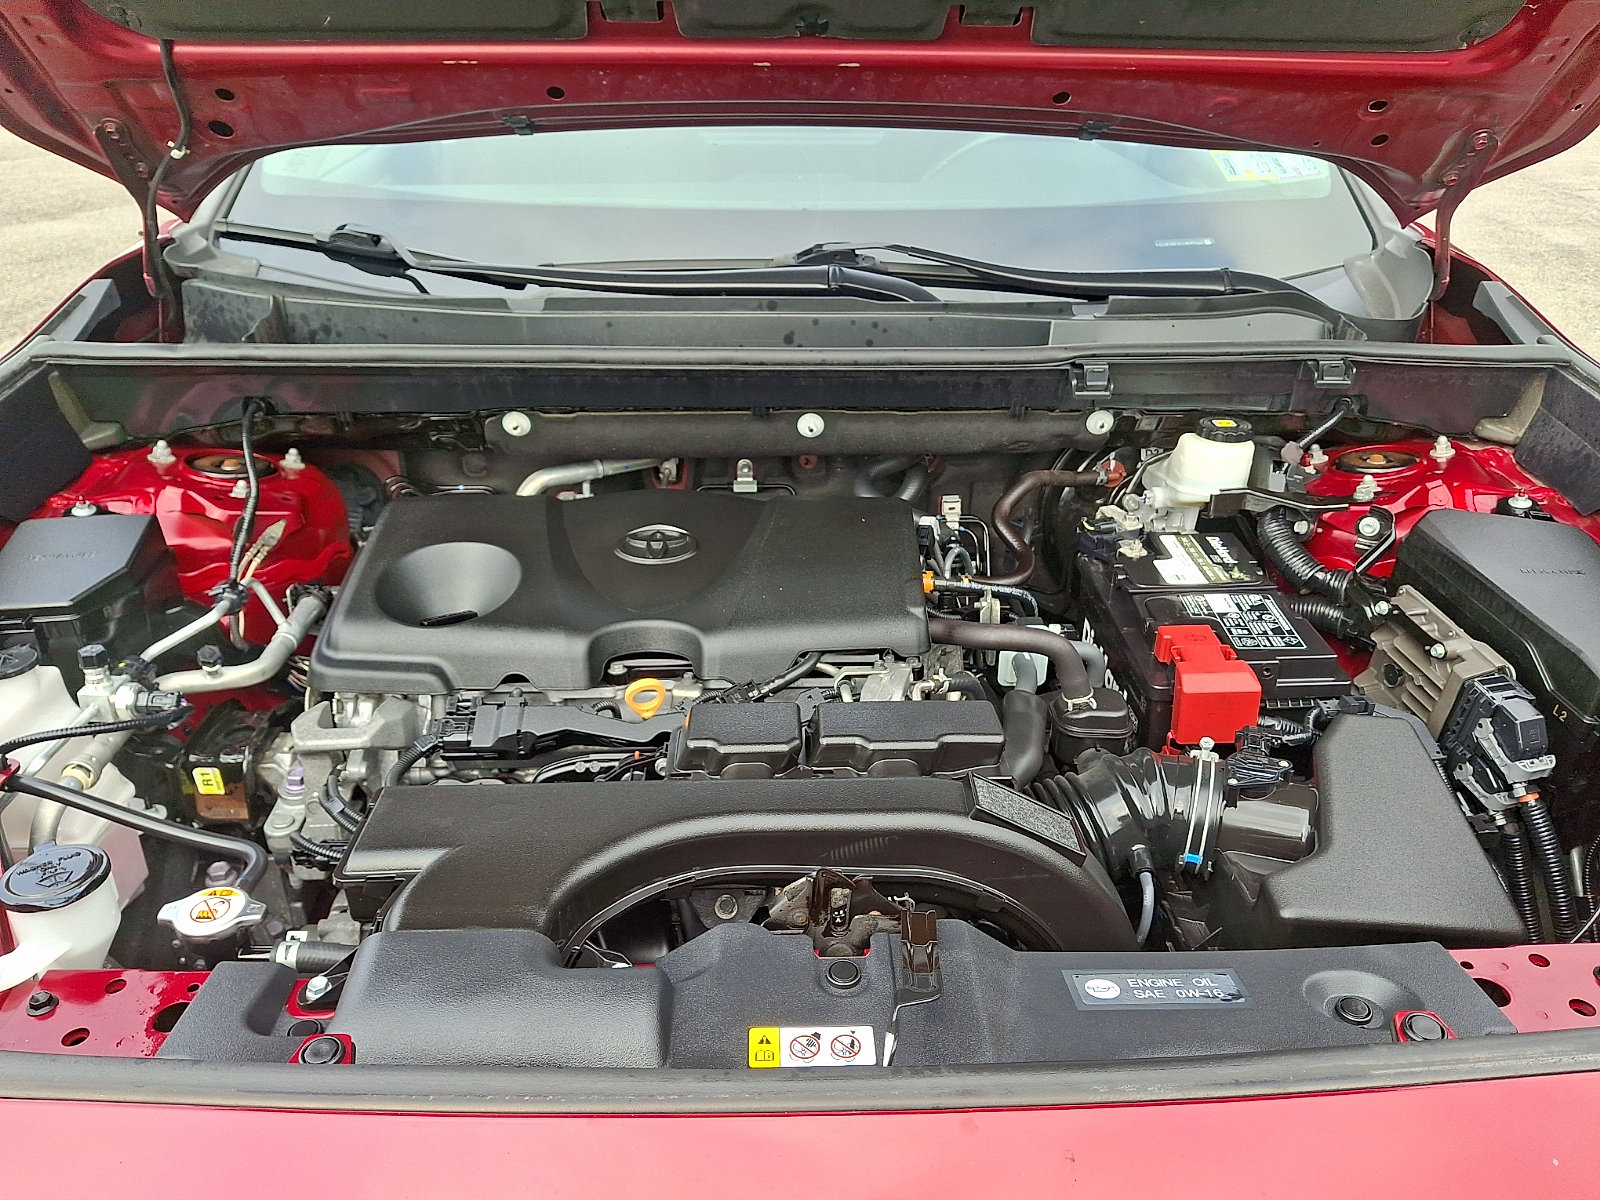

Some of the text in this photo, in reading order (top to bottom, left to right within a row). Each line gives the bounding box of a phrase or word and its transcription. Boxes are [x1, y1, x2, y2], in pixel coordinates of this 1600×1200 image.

[1552, 704, 1568, 722] L2
[57, 851, 82, 863] FLUID
[1126, 977, 1219, 988] ENGINE OIL
[1134, 989, 1225, 999] SAE 0W-16
